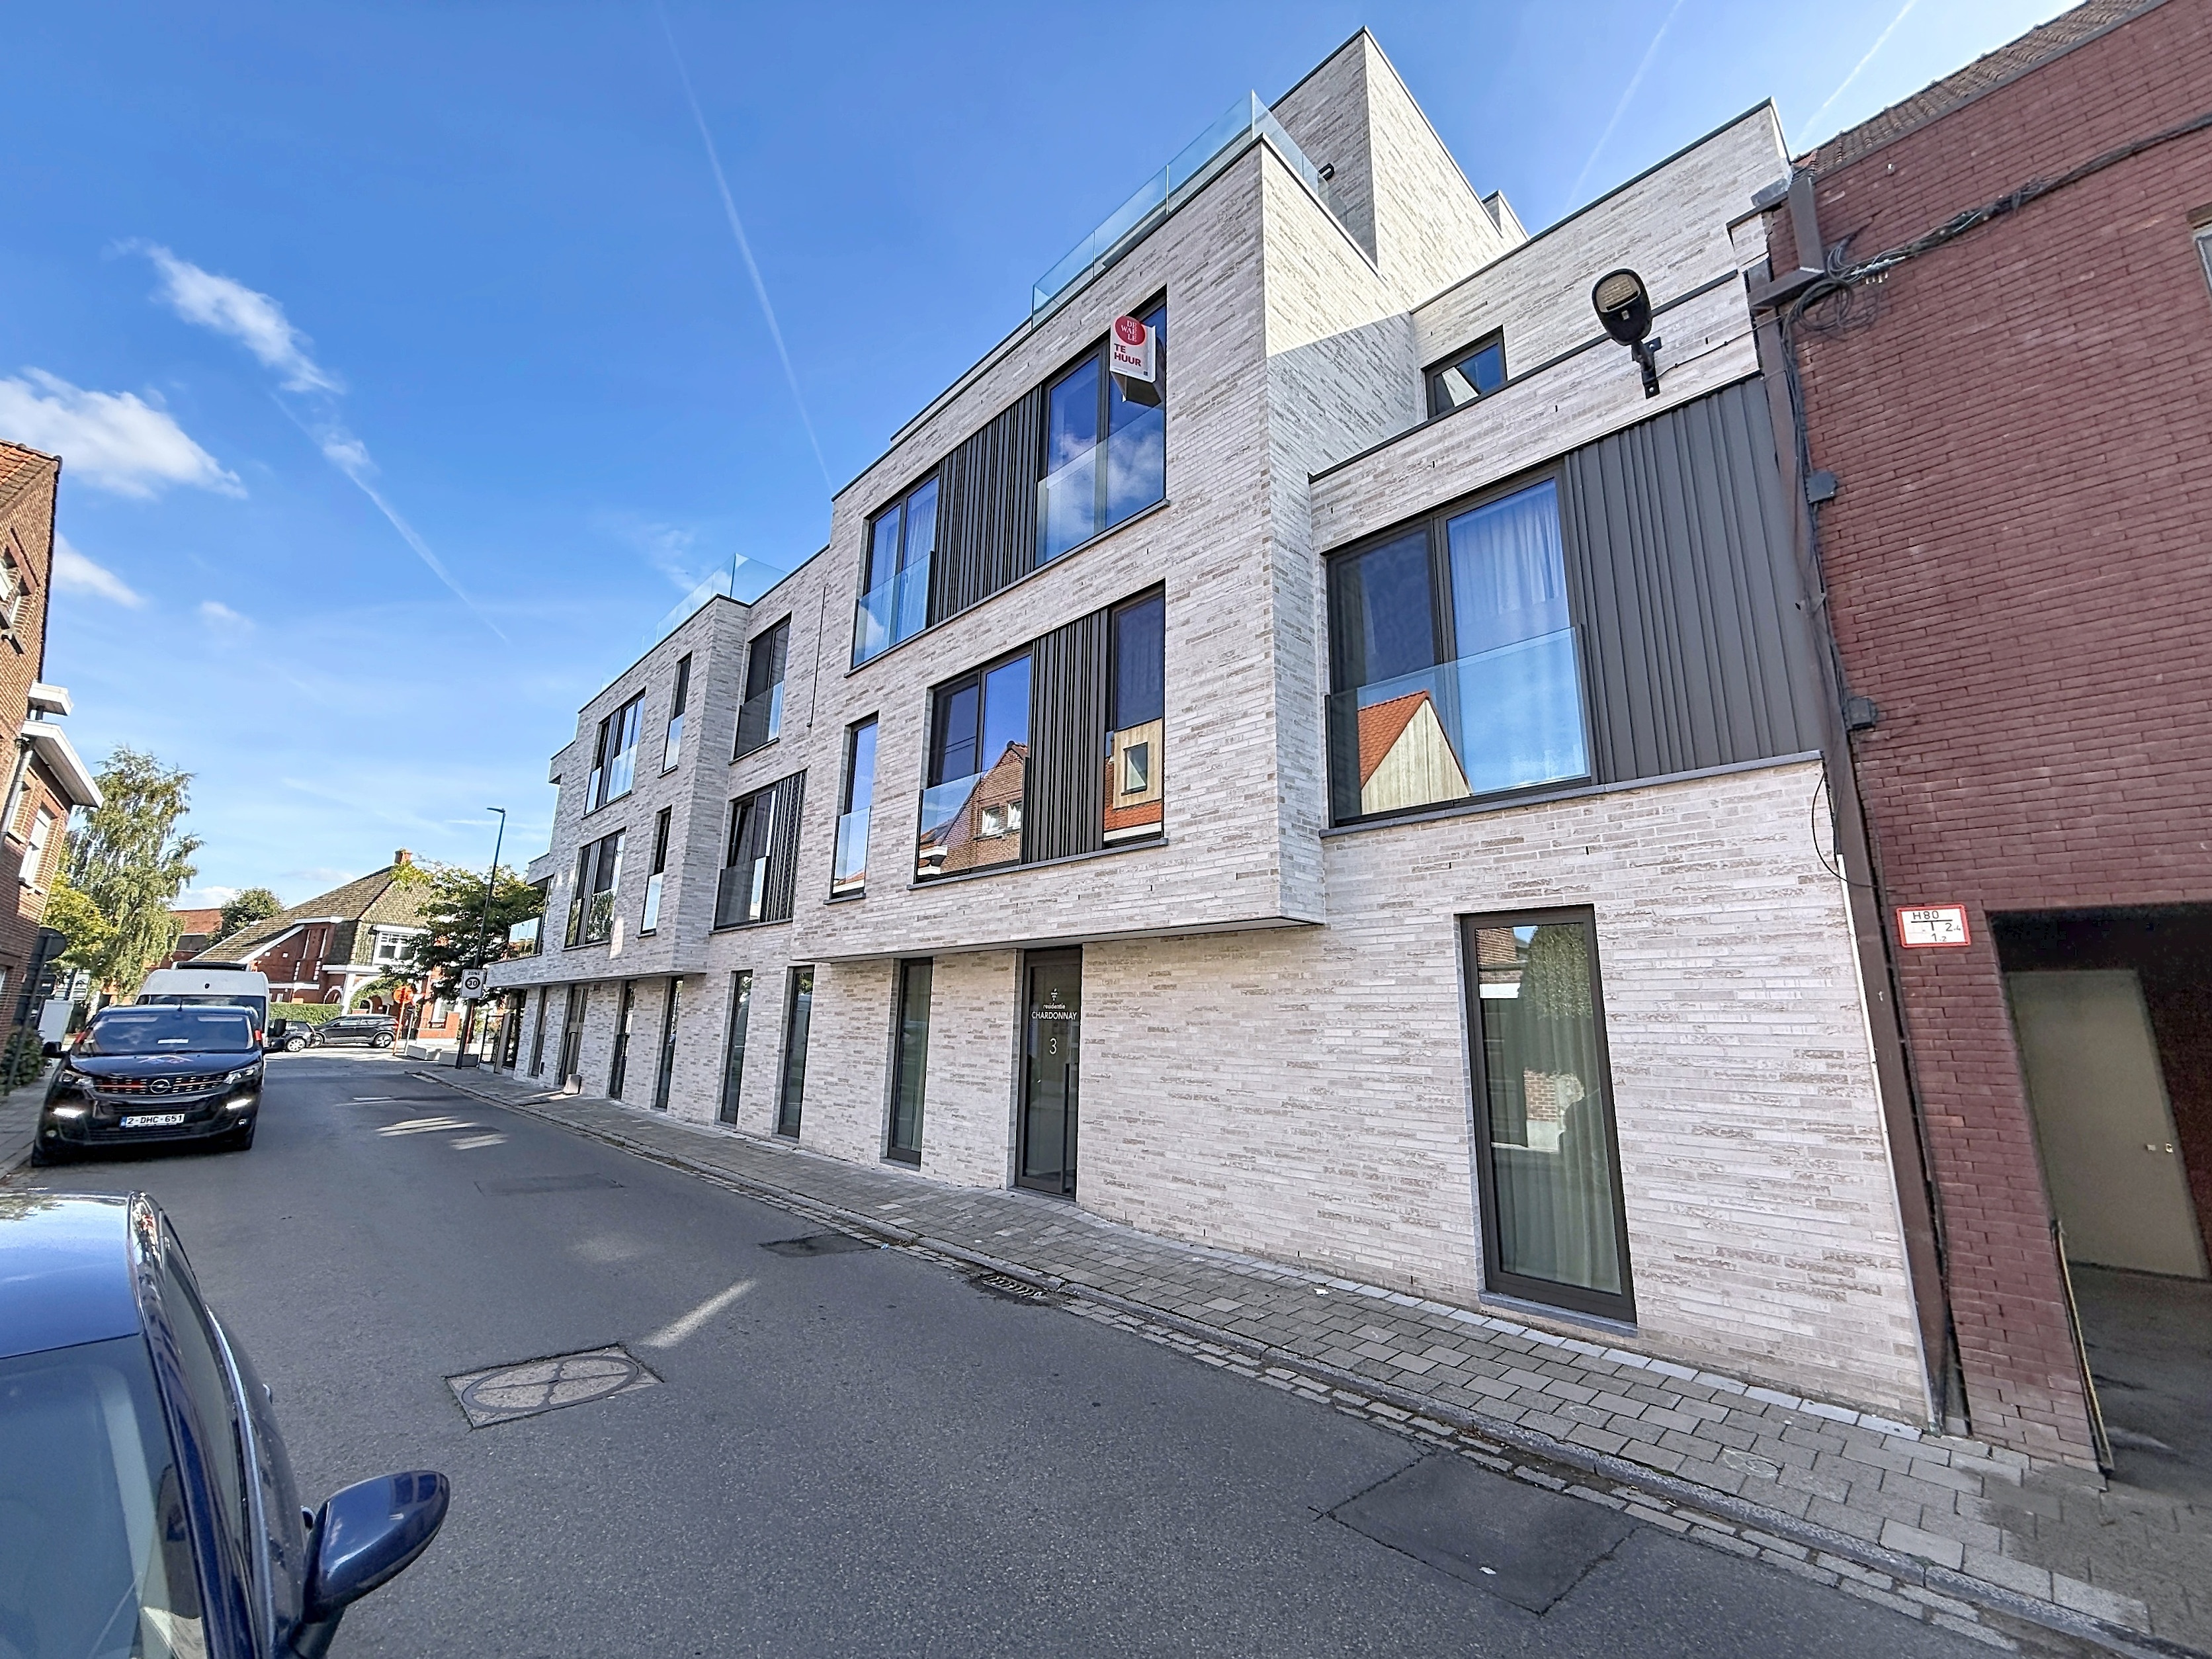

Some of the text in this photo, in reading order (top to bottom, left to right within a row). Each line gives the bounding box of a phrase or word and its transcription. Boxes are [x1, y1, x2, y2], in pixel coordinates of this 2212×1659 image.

[1127, 333, 1137, 342] LE
[1114, 343, 1126, 353] TE
[1114, 352, 1141, 366] HUUR
[1912, 910, 1939, 919] H80
[1049, 1038, 1057, 1054] 3
[127, 1115, 183, 1125] 2-DHC-651
